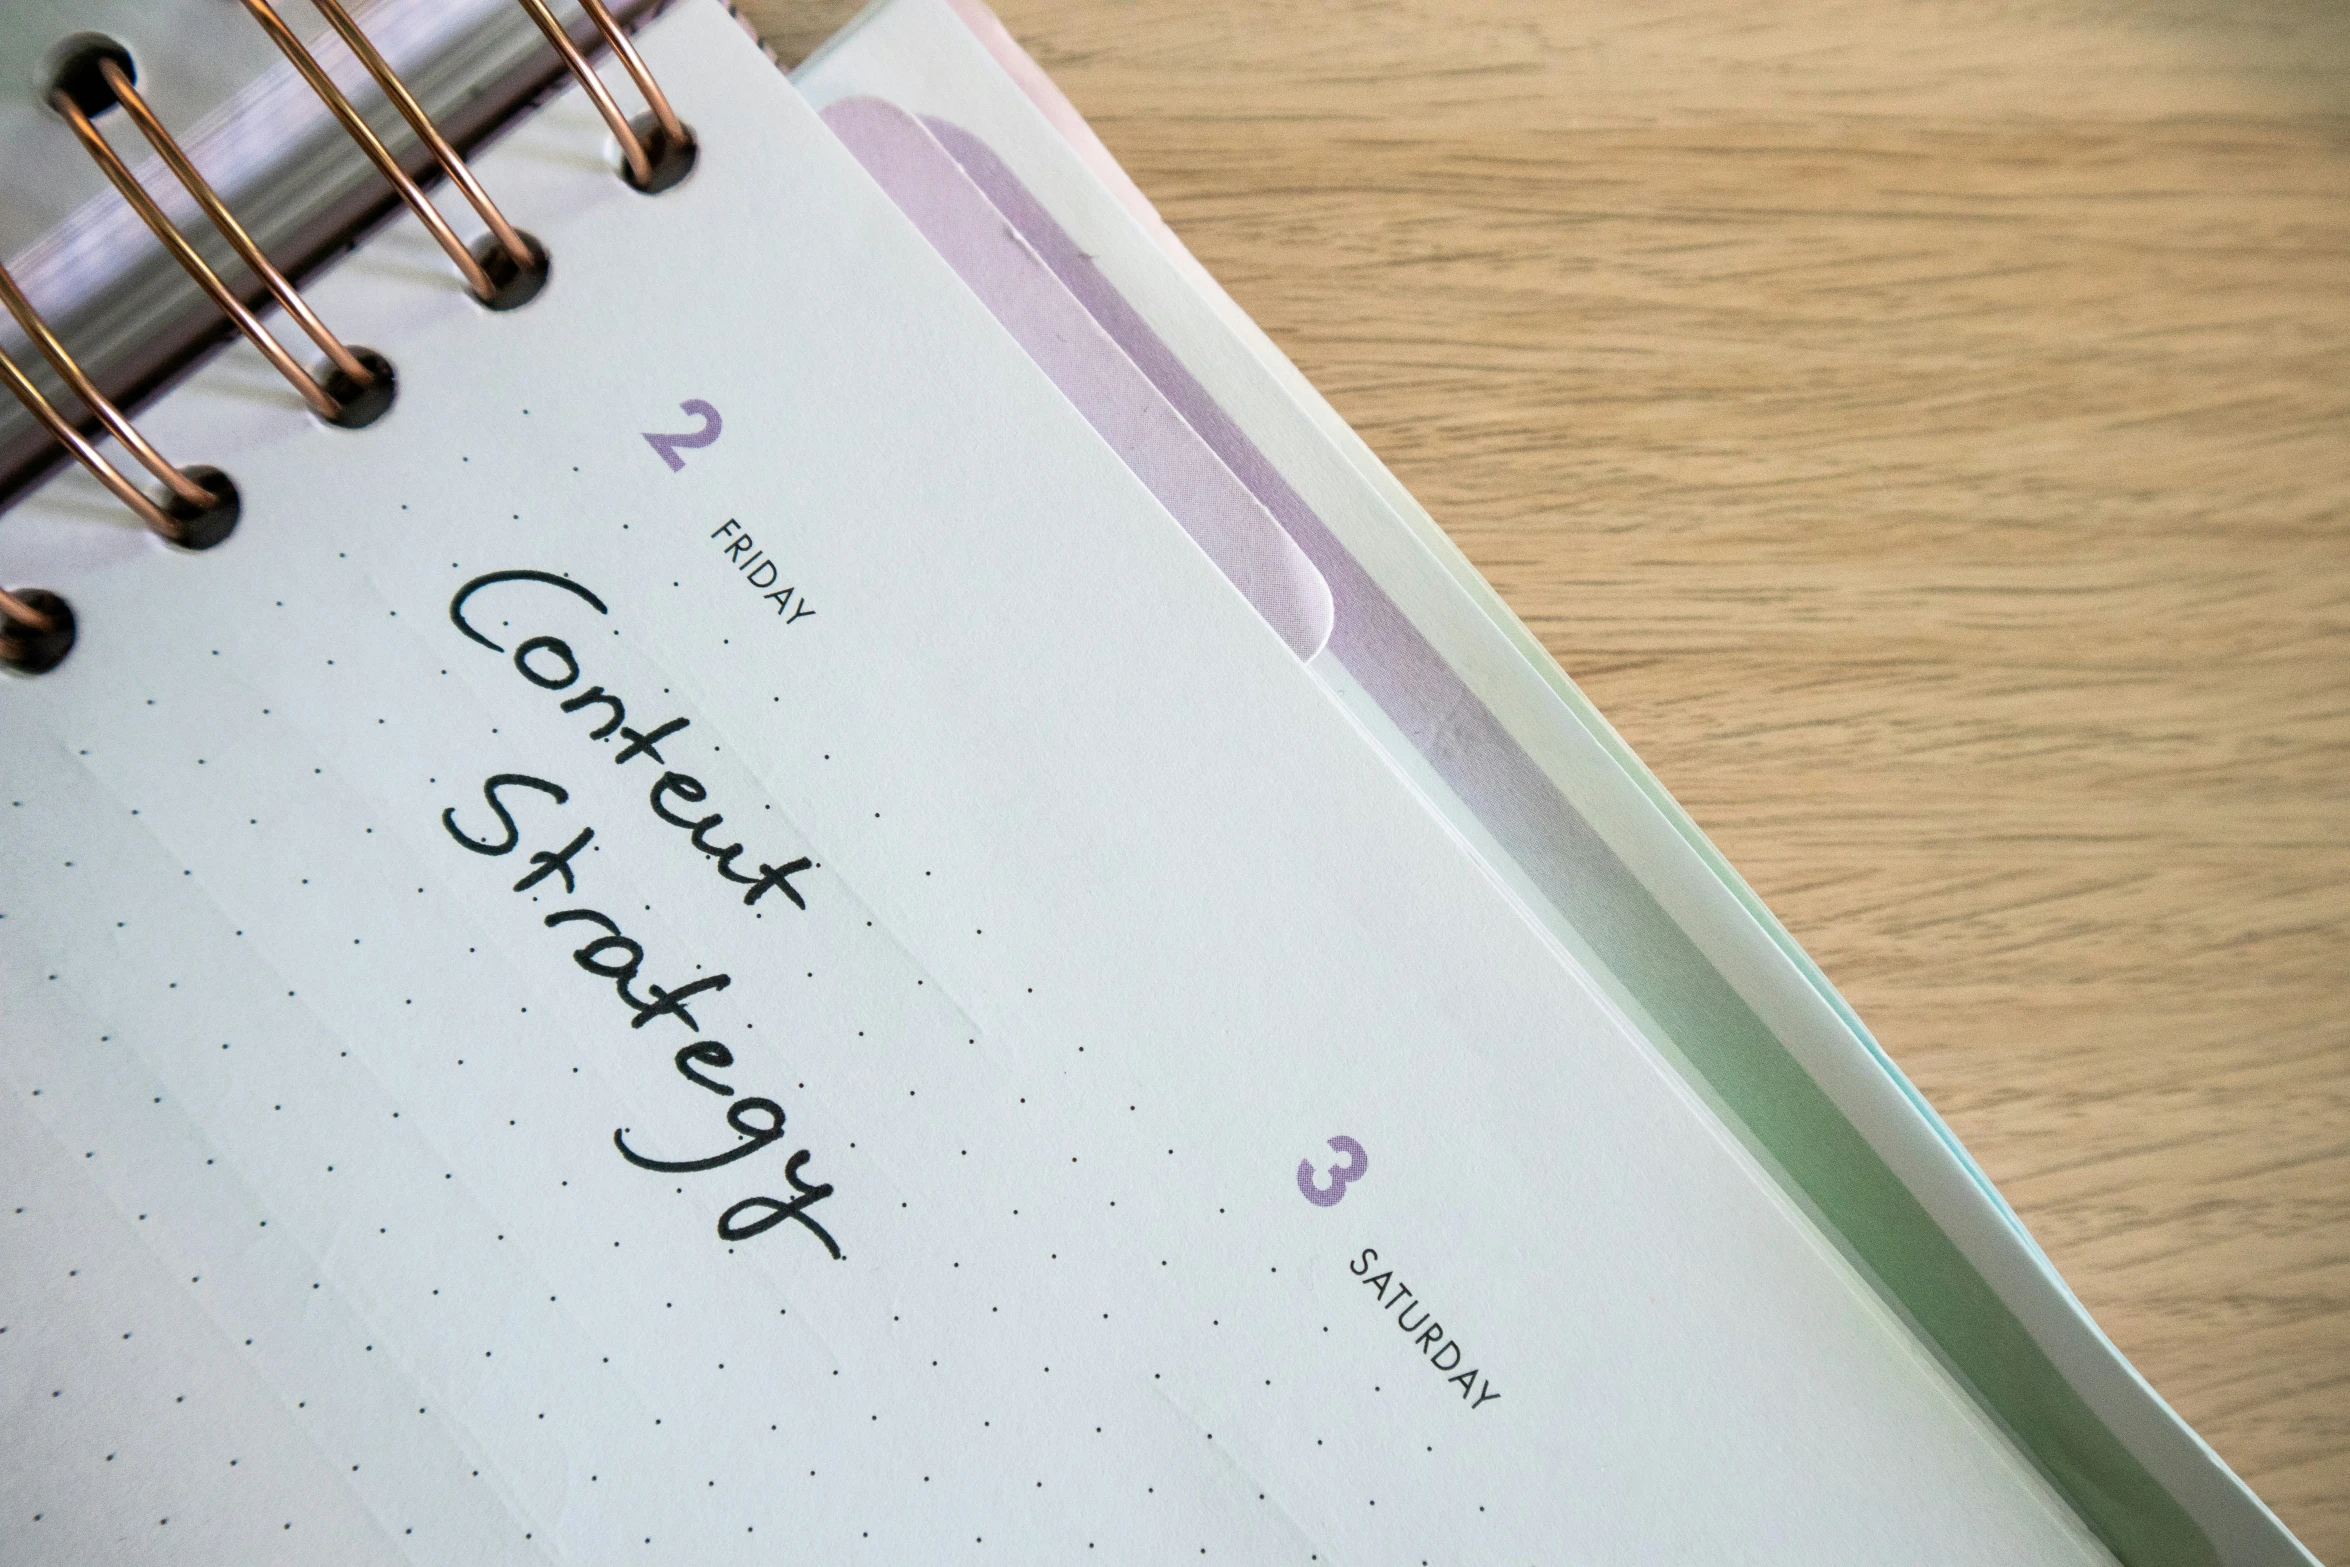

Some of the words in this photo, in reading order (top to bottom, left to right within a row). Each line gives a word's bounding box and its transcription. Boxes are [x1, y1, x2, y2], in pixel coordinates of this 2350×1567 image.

[641, 399, 723, 473] 2
[711, 518, 816, 625] FRIDAY
[449, 569, 813, 911] Content
[442, 773, 842, 1261] Strategy
[1297, 1135, 1368, 1207] 3
[1349, 1248, 1501, 1409] SATURDAY
